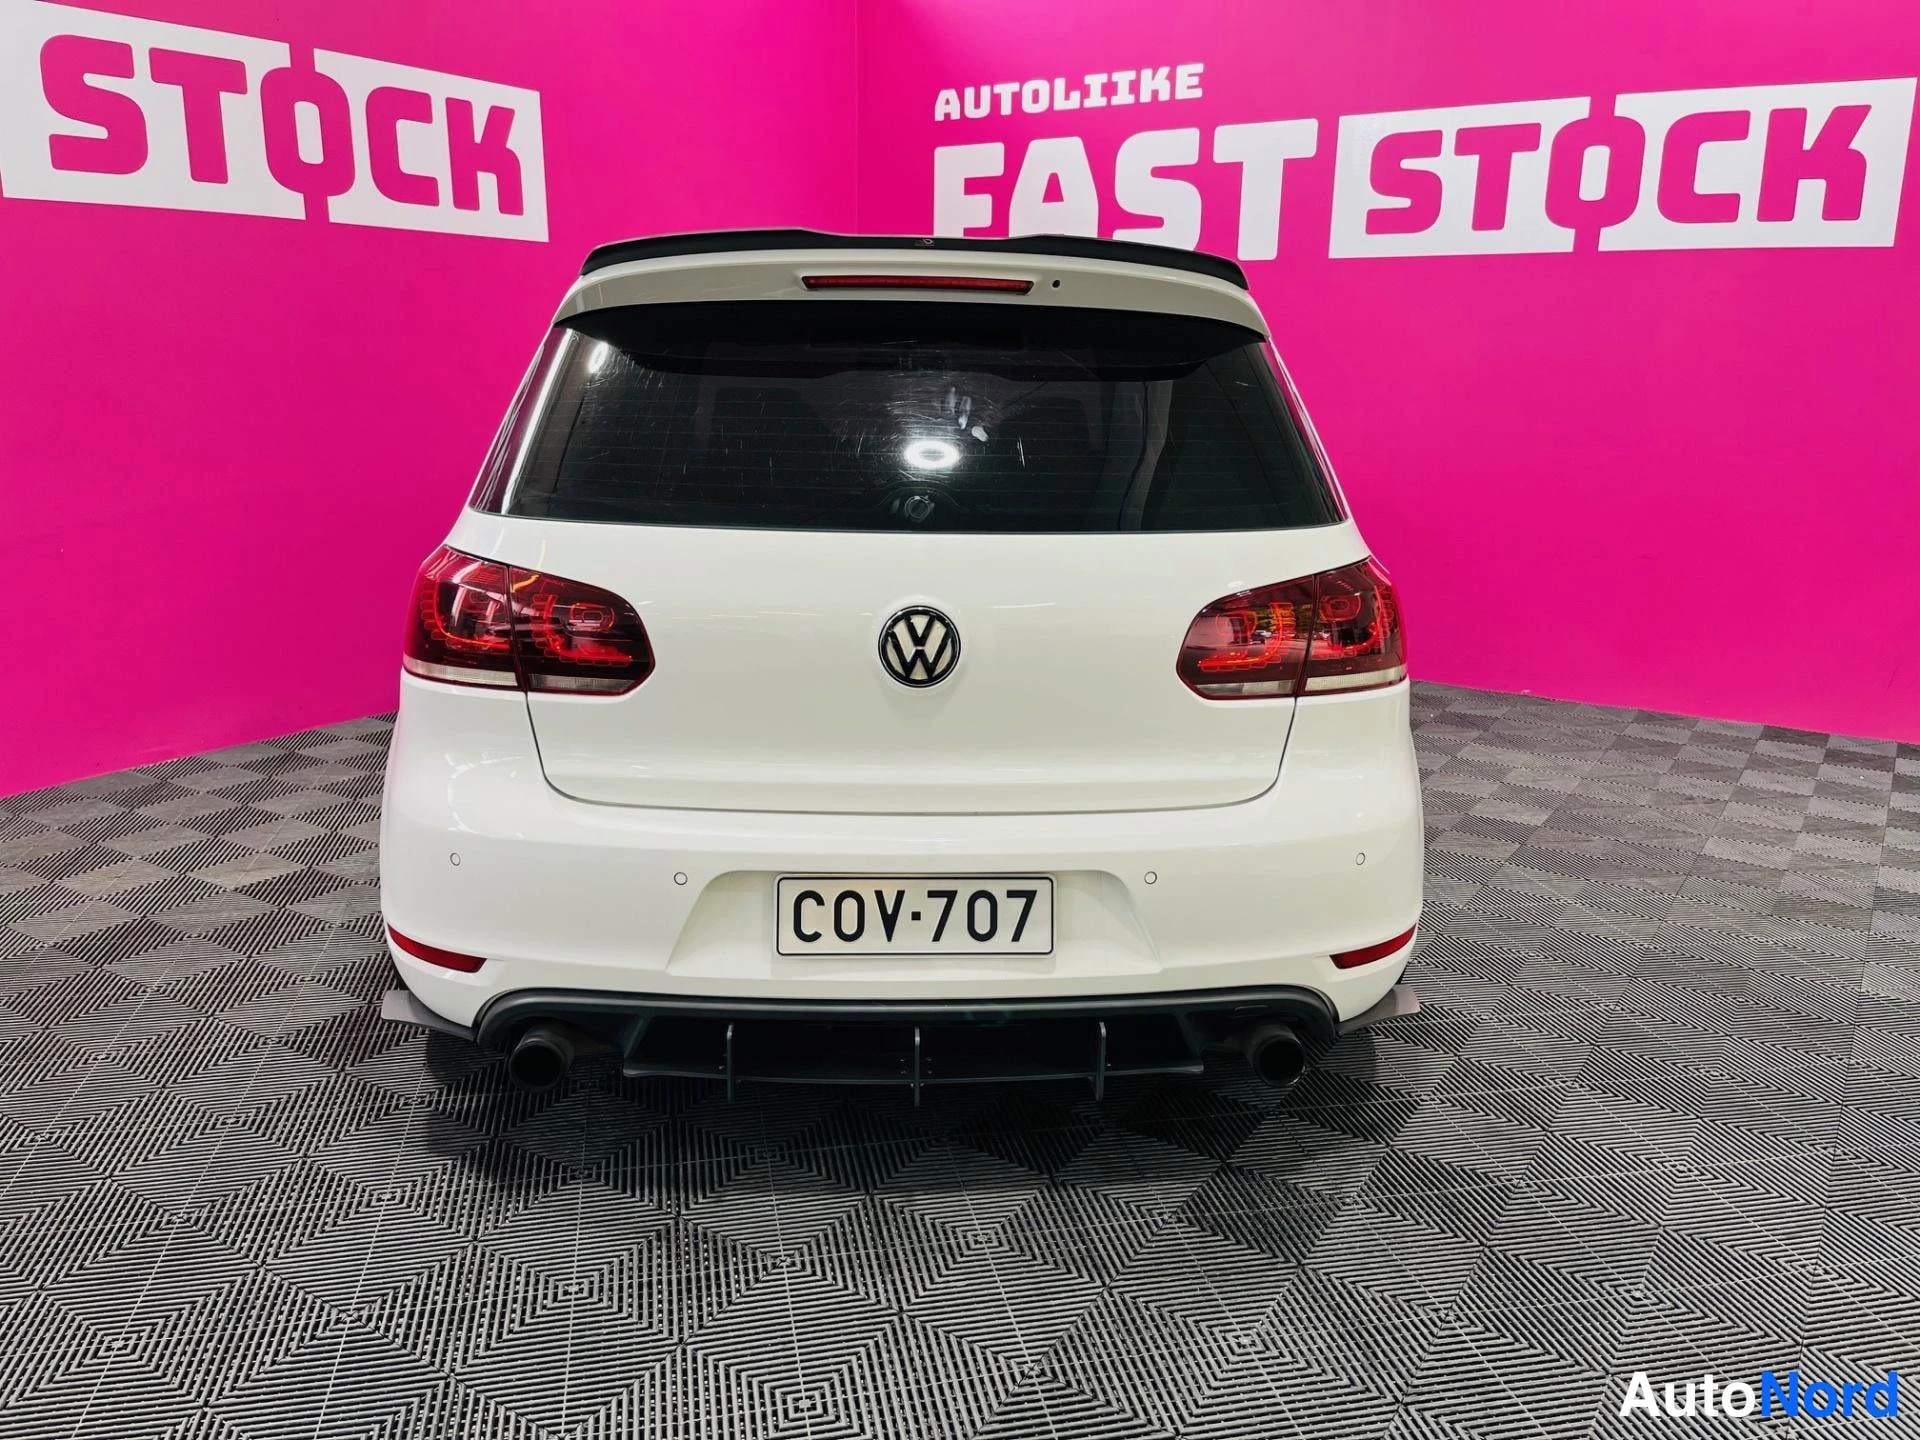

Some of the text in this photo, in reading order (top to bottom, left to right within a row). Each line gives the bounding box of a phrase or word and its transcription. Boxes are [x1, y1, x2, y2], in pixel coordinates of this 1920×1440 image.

[40, 34, 525, 216] STOCK
[934, 63, 1204, 120] AUTOLIIKE
[934, 104, 1868, 260] FAST STOCK
